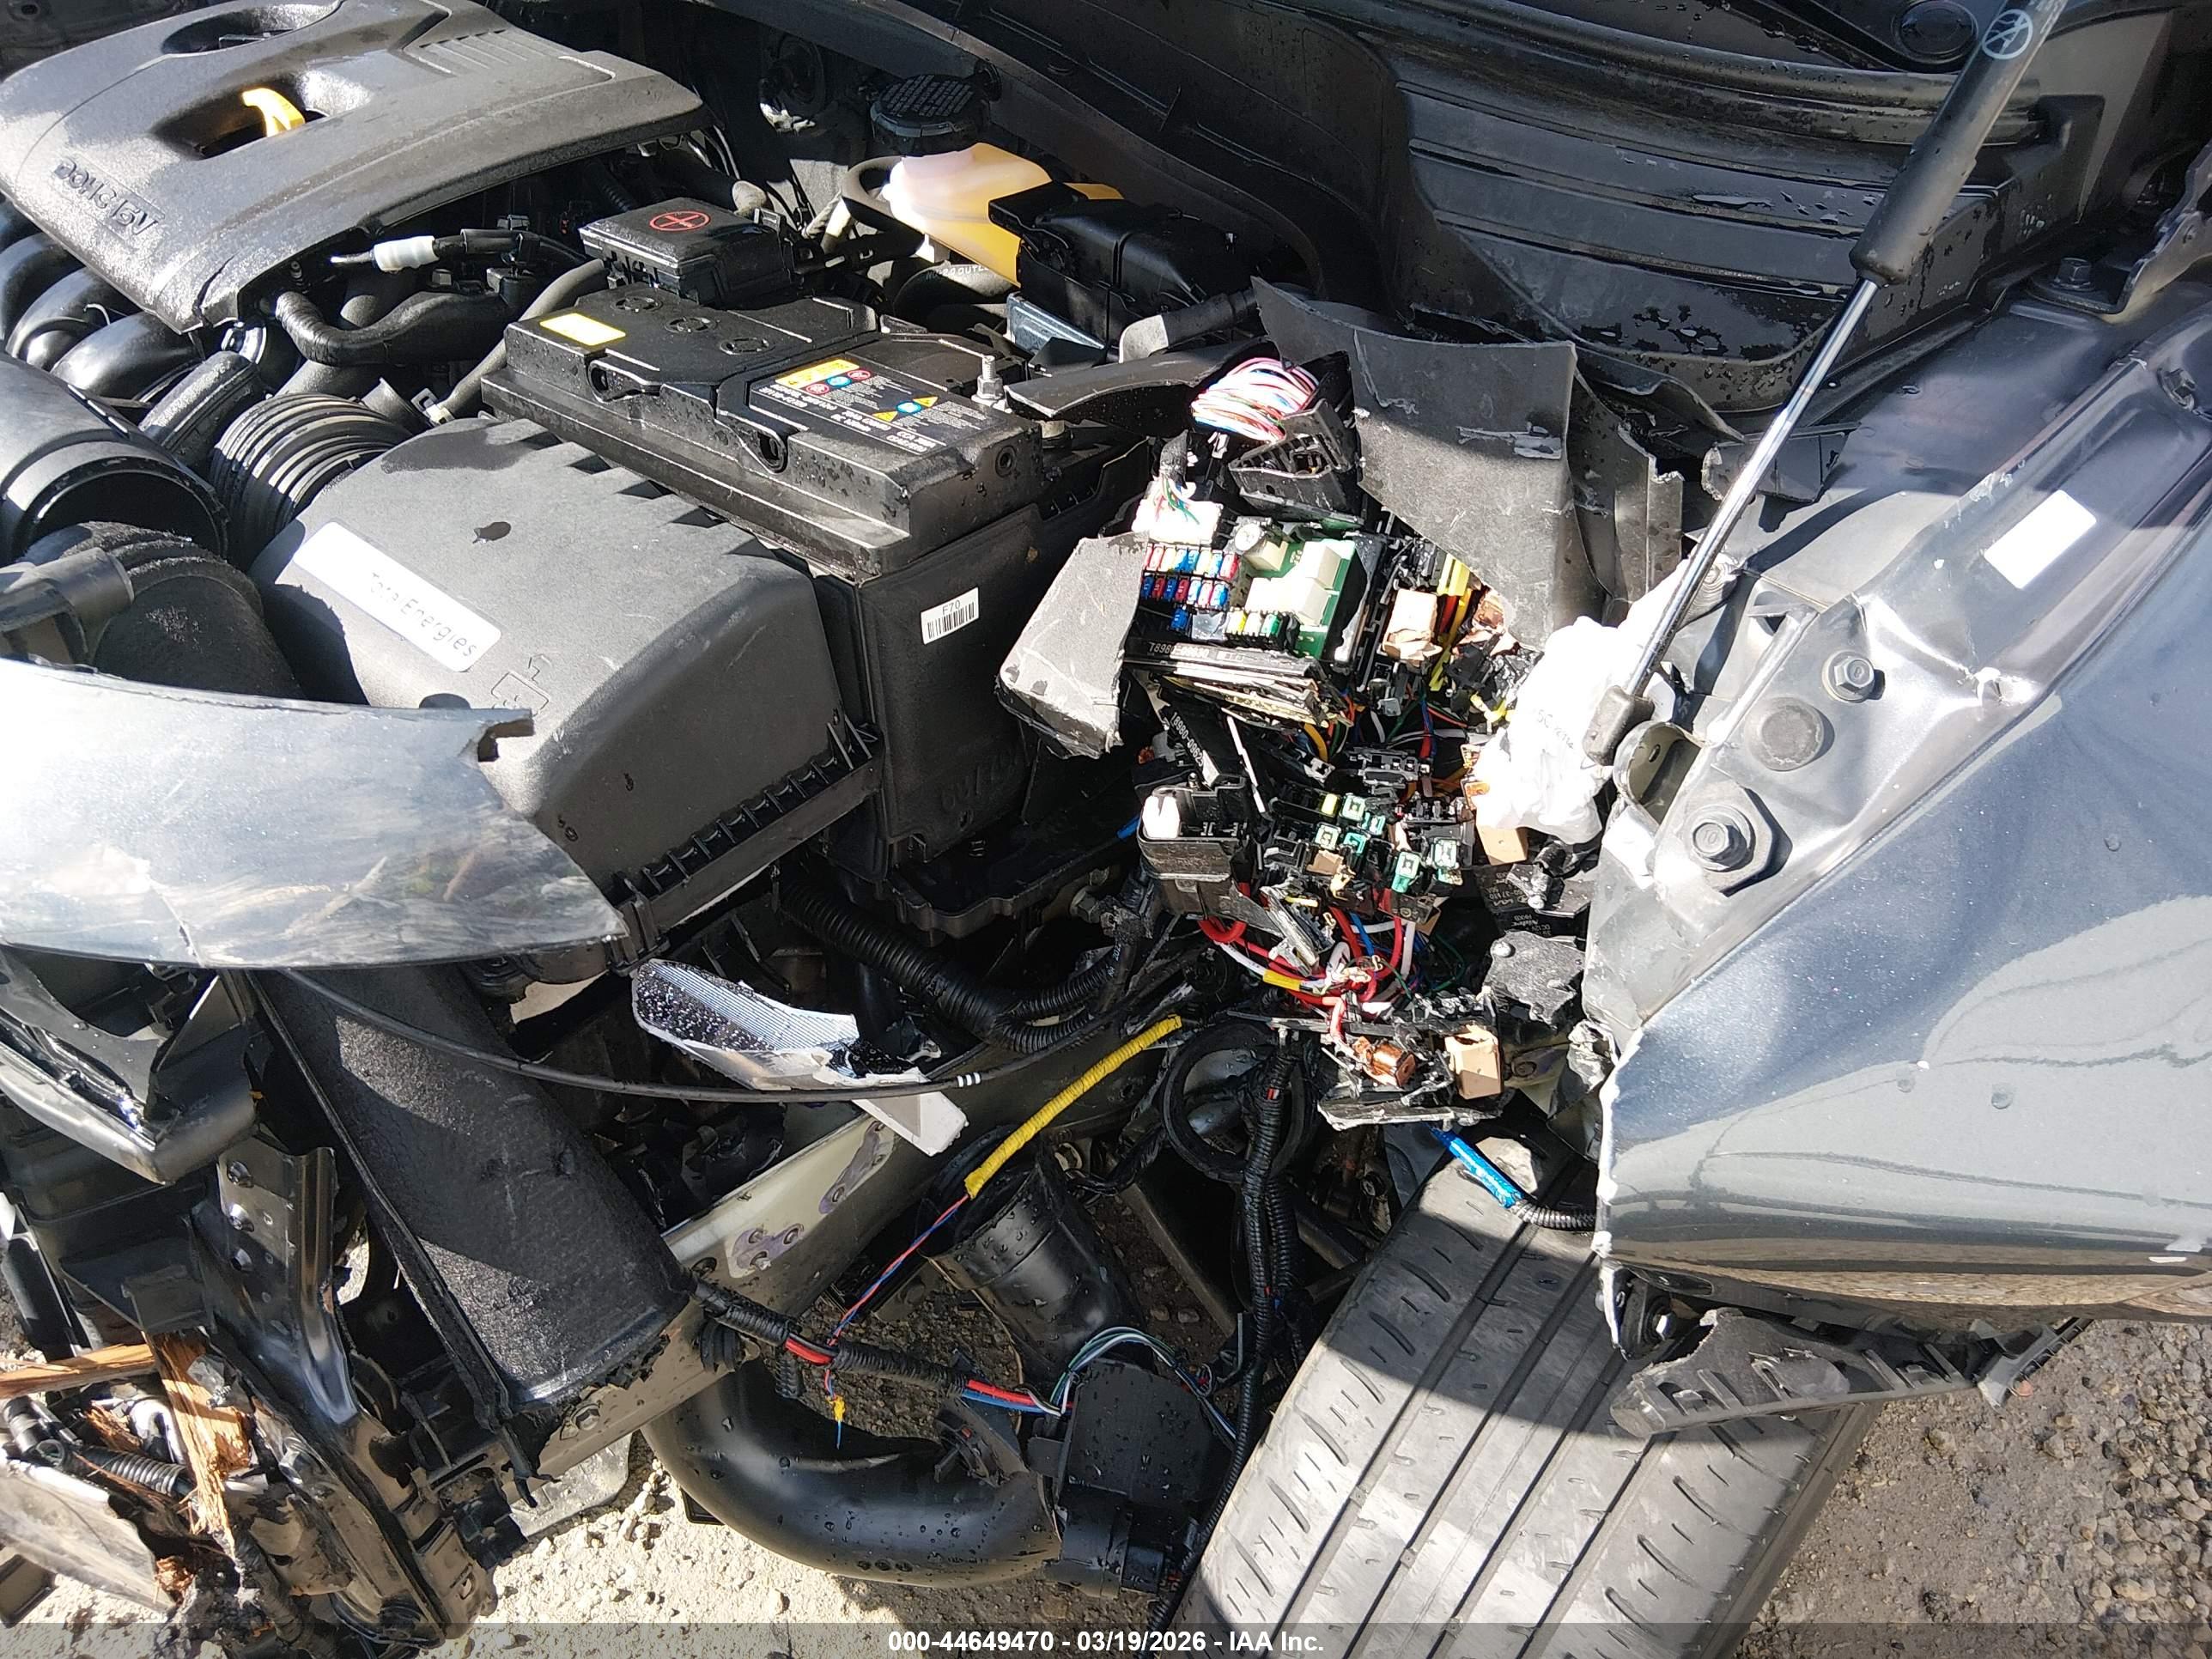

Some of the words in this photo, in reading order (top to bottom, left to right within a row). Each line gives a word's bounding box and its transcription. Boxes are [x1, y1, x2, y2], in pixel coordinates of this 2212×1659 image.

[54, 156, 117, 210] DOHC
[109, 198, 159, 235] 16V
[942, 599, 961, 616] F70
